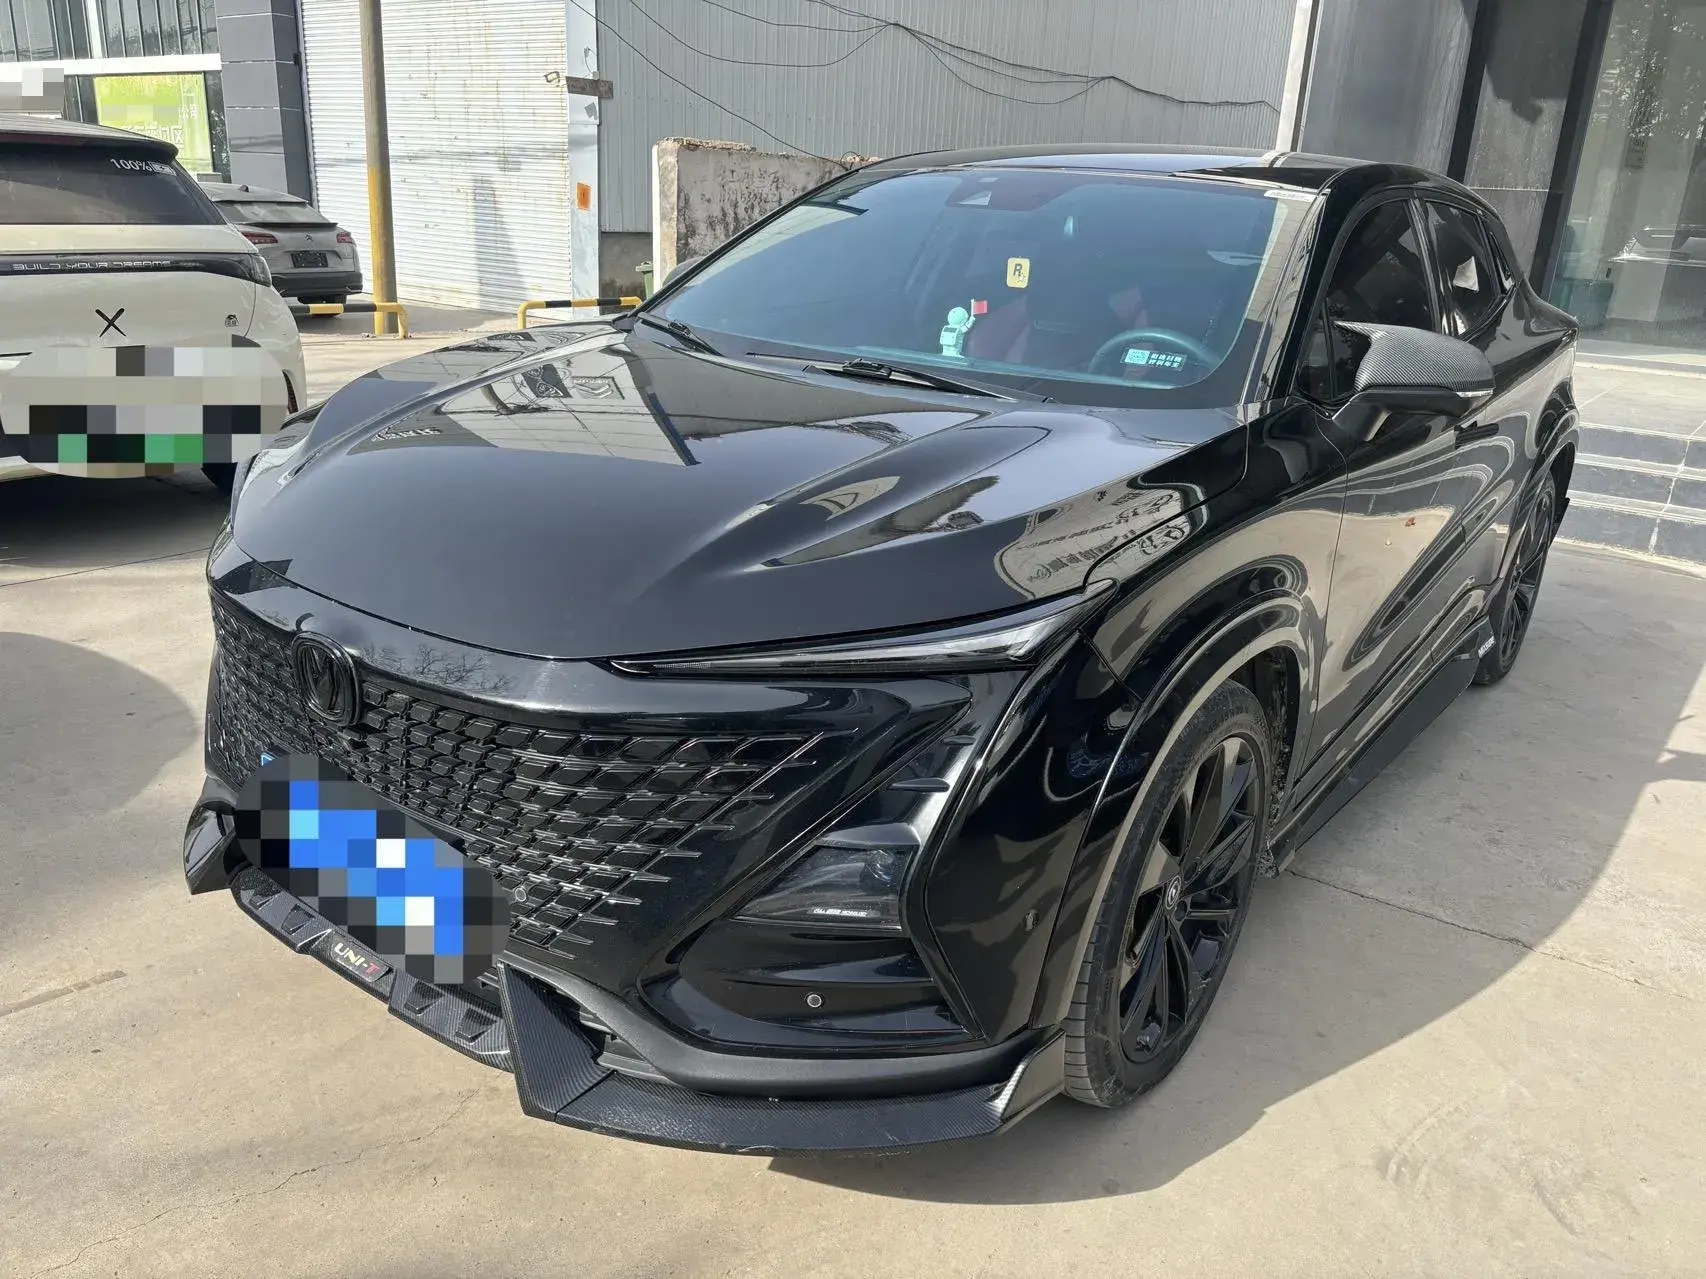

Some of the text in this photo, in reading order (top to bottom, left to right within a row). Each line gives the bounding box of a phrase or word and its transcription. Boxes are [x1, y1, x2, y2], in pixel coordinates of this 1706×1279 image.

[110, 158, 152, 172] 100%
[12, 263, 61, 271] BUILD
[66, 262, 109, 270] YOUR
[334, 942, 380, 975] UNI-T
